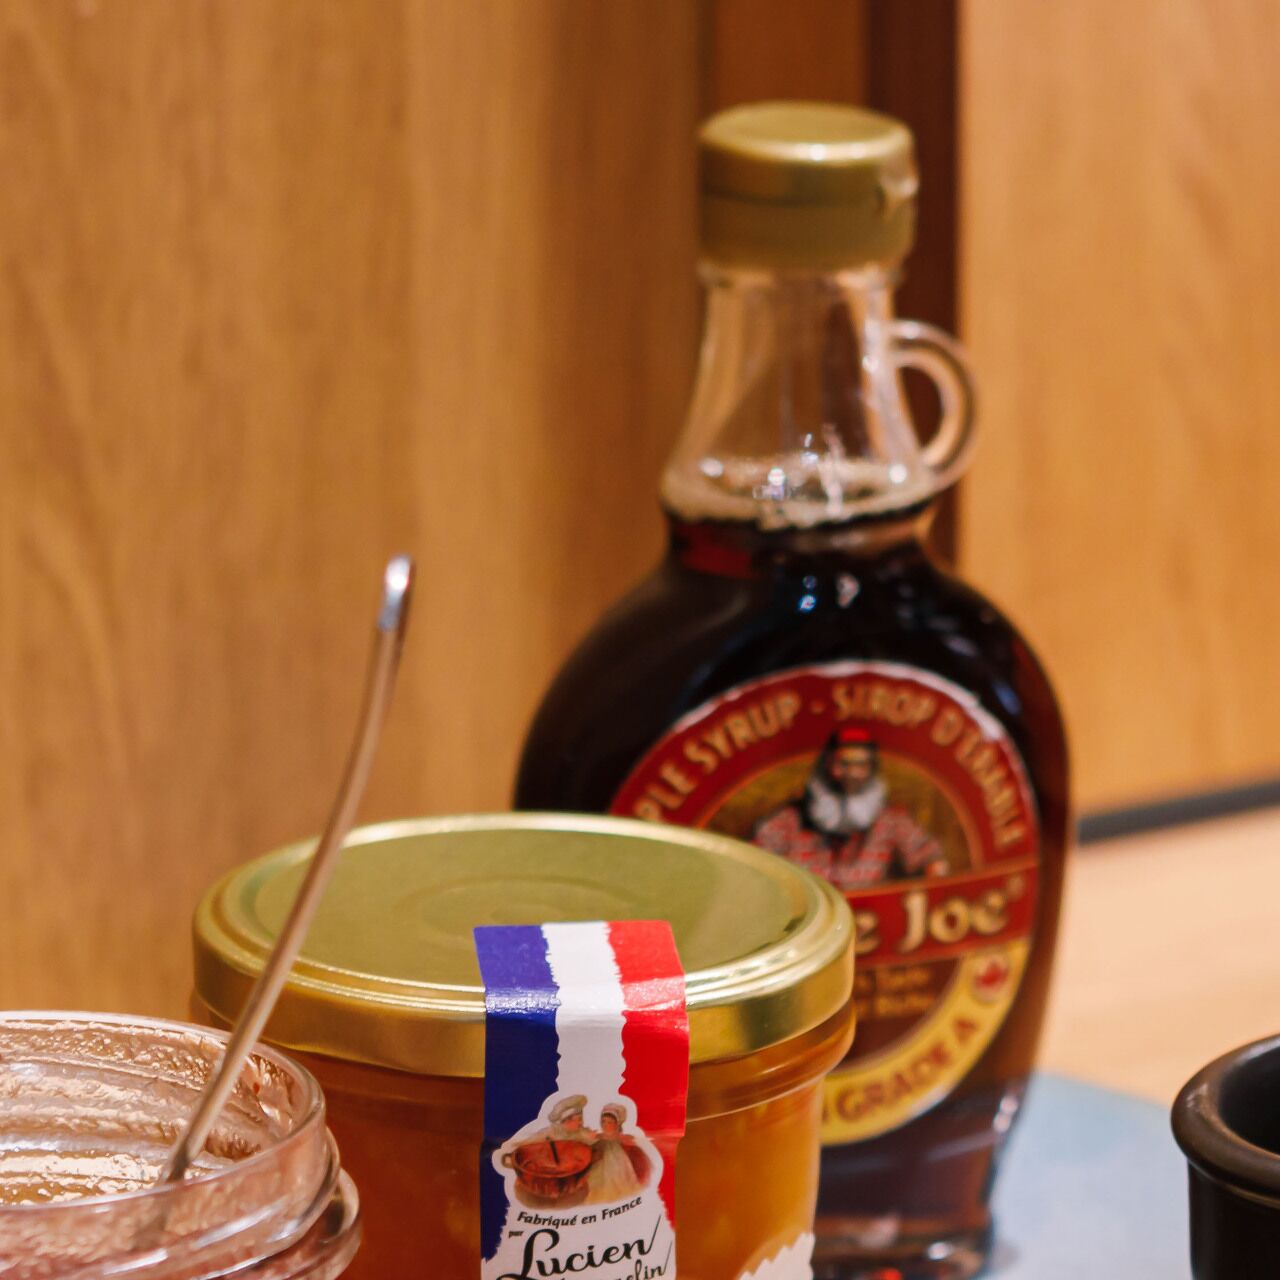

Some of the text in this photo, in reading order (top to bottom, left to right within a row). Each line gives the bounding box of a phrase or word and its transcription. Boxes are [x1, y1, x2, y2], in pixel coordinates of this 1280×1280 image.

[632, 760, 699, 822] PLE
[682, 689, 801, 774] SYRUP
[831, 682, 936, 728] SIROP
[834, 1042, 951, 1123] GRADE
[951, 1013, 978, 1043] A
[517, 1197, 642, 1229] Fabriqué en France
